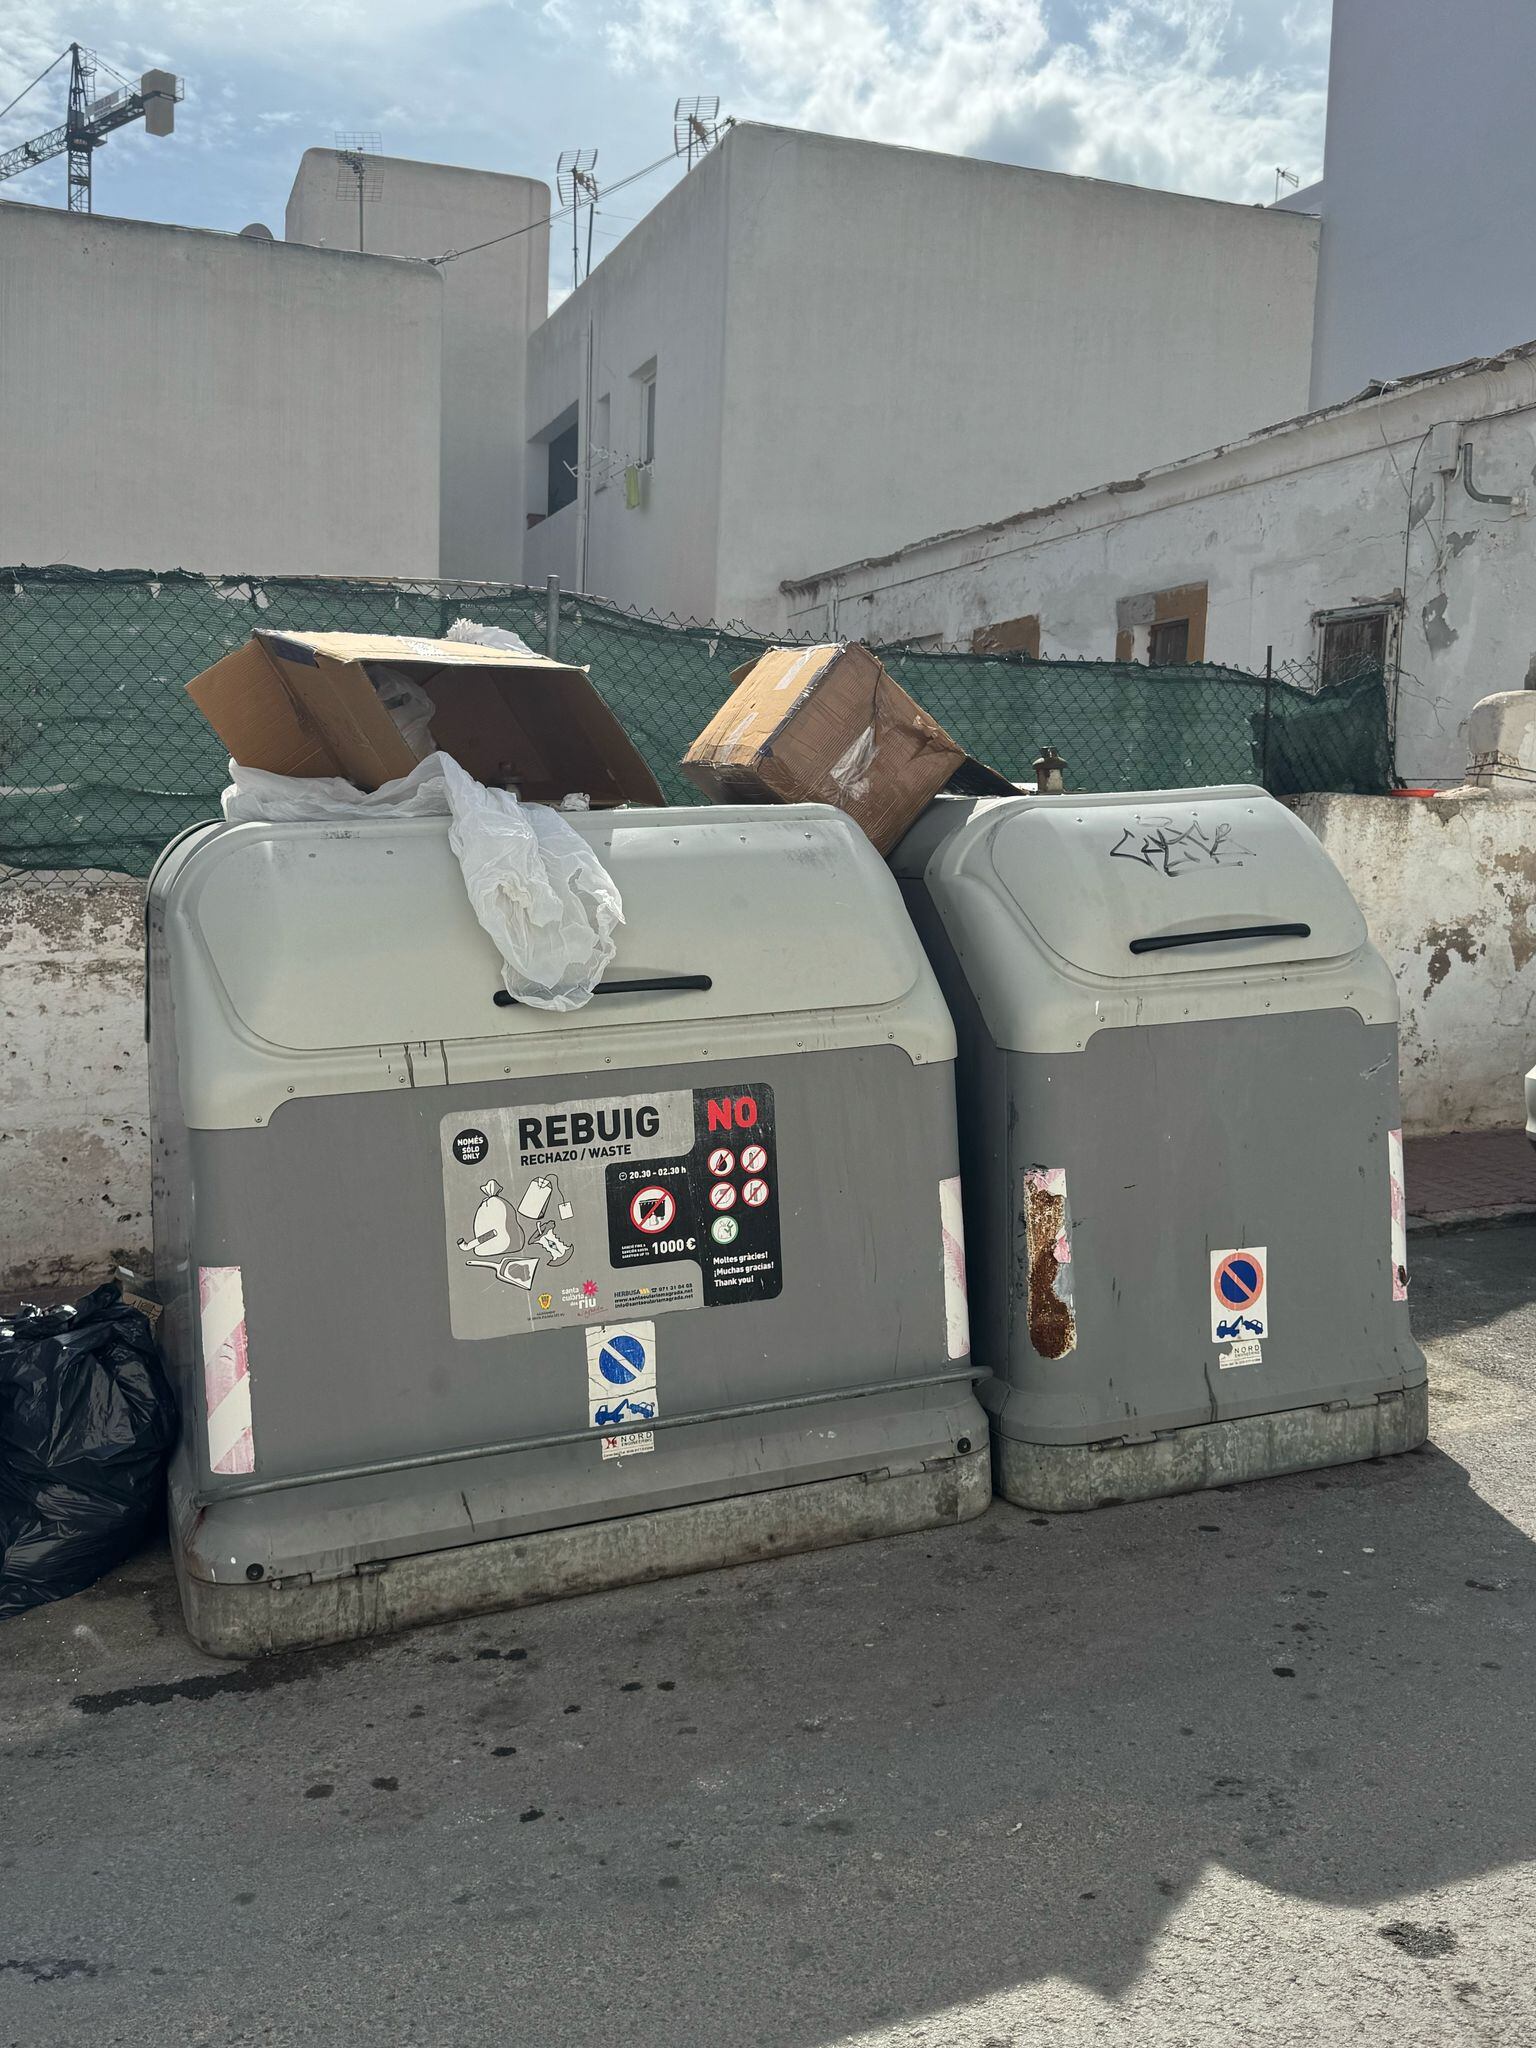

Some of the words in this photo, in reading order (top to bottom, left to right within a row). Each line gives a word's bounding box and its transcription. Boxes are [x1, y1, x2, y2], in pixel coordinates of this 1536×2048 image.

[707, 1096, 758, 1131] NO
[518, 1105, 660, 1150] REBUIG
[457, 1135, 484, 1146] NOMÉS
[462, 1145, 480, 1154] SÓLO
[520, 1151, 578, 1166] RECHAZO
[580, 1148, 586, 1161] /
[588, 1144, 632, 1159] WASTE
[629, 1170, 651, 1180] 20.30
[658, 1167, 680, 1176] 02.30
[681, 1166, 687, 1174] h
[713, 1256, 738, 1265] Moltes
[738, 1251, 768, 1264] gràcies!
[714, 1266, 744, 1277] ¡Muchas
[745, 1262, 774, 1274] gracias!
[714, 1278, 737, 1287] Thank
[738, 1275, 754, 1286] you!
[614, 1289, 640, 1298] HERBUSA
[578, 1296, 597, 1309] riu
[1234, 1345, 1260, 1354] NORD
[621, 1431, 652, 1442] NORD
